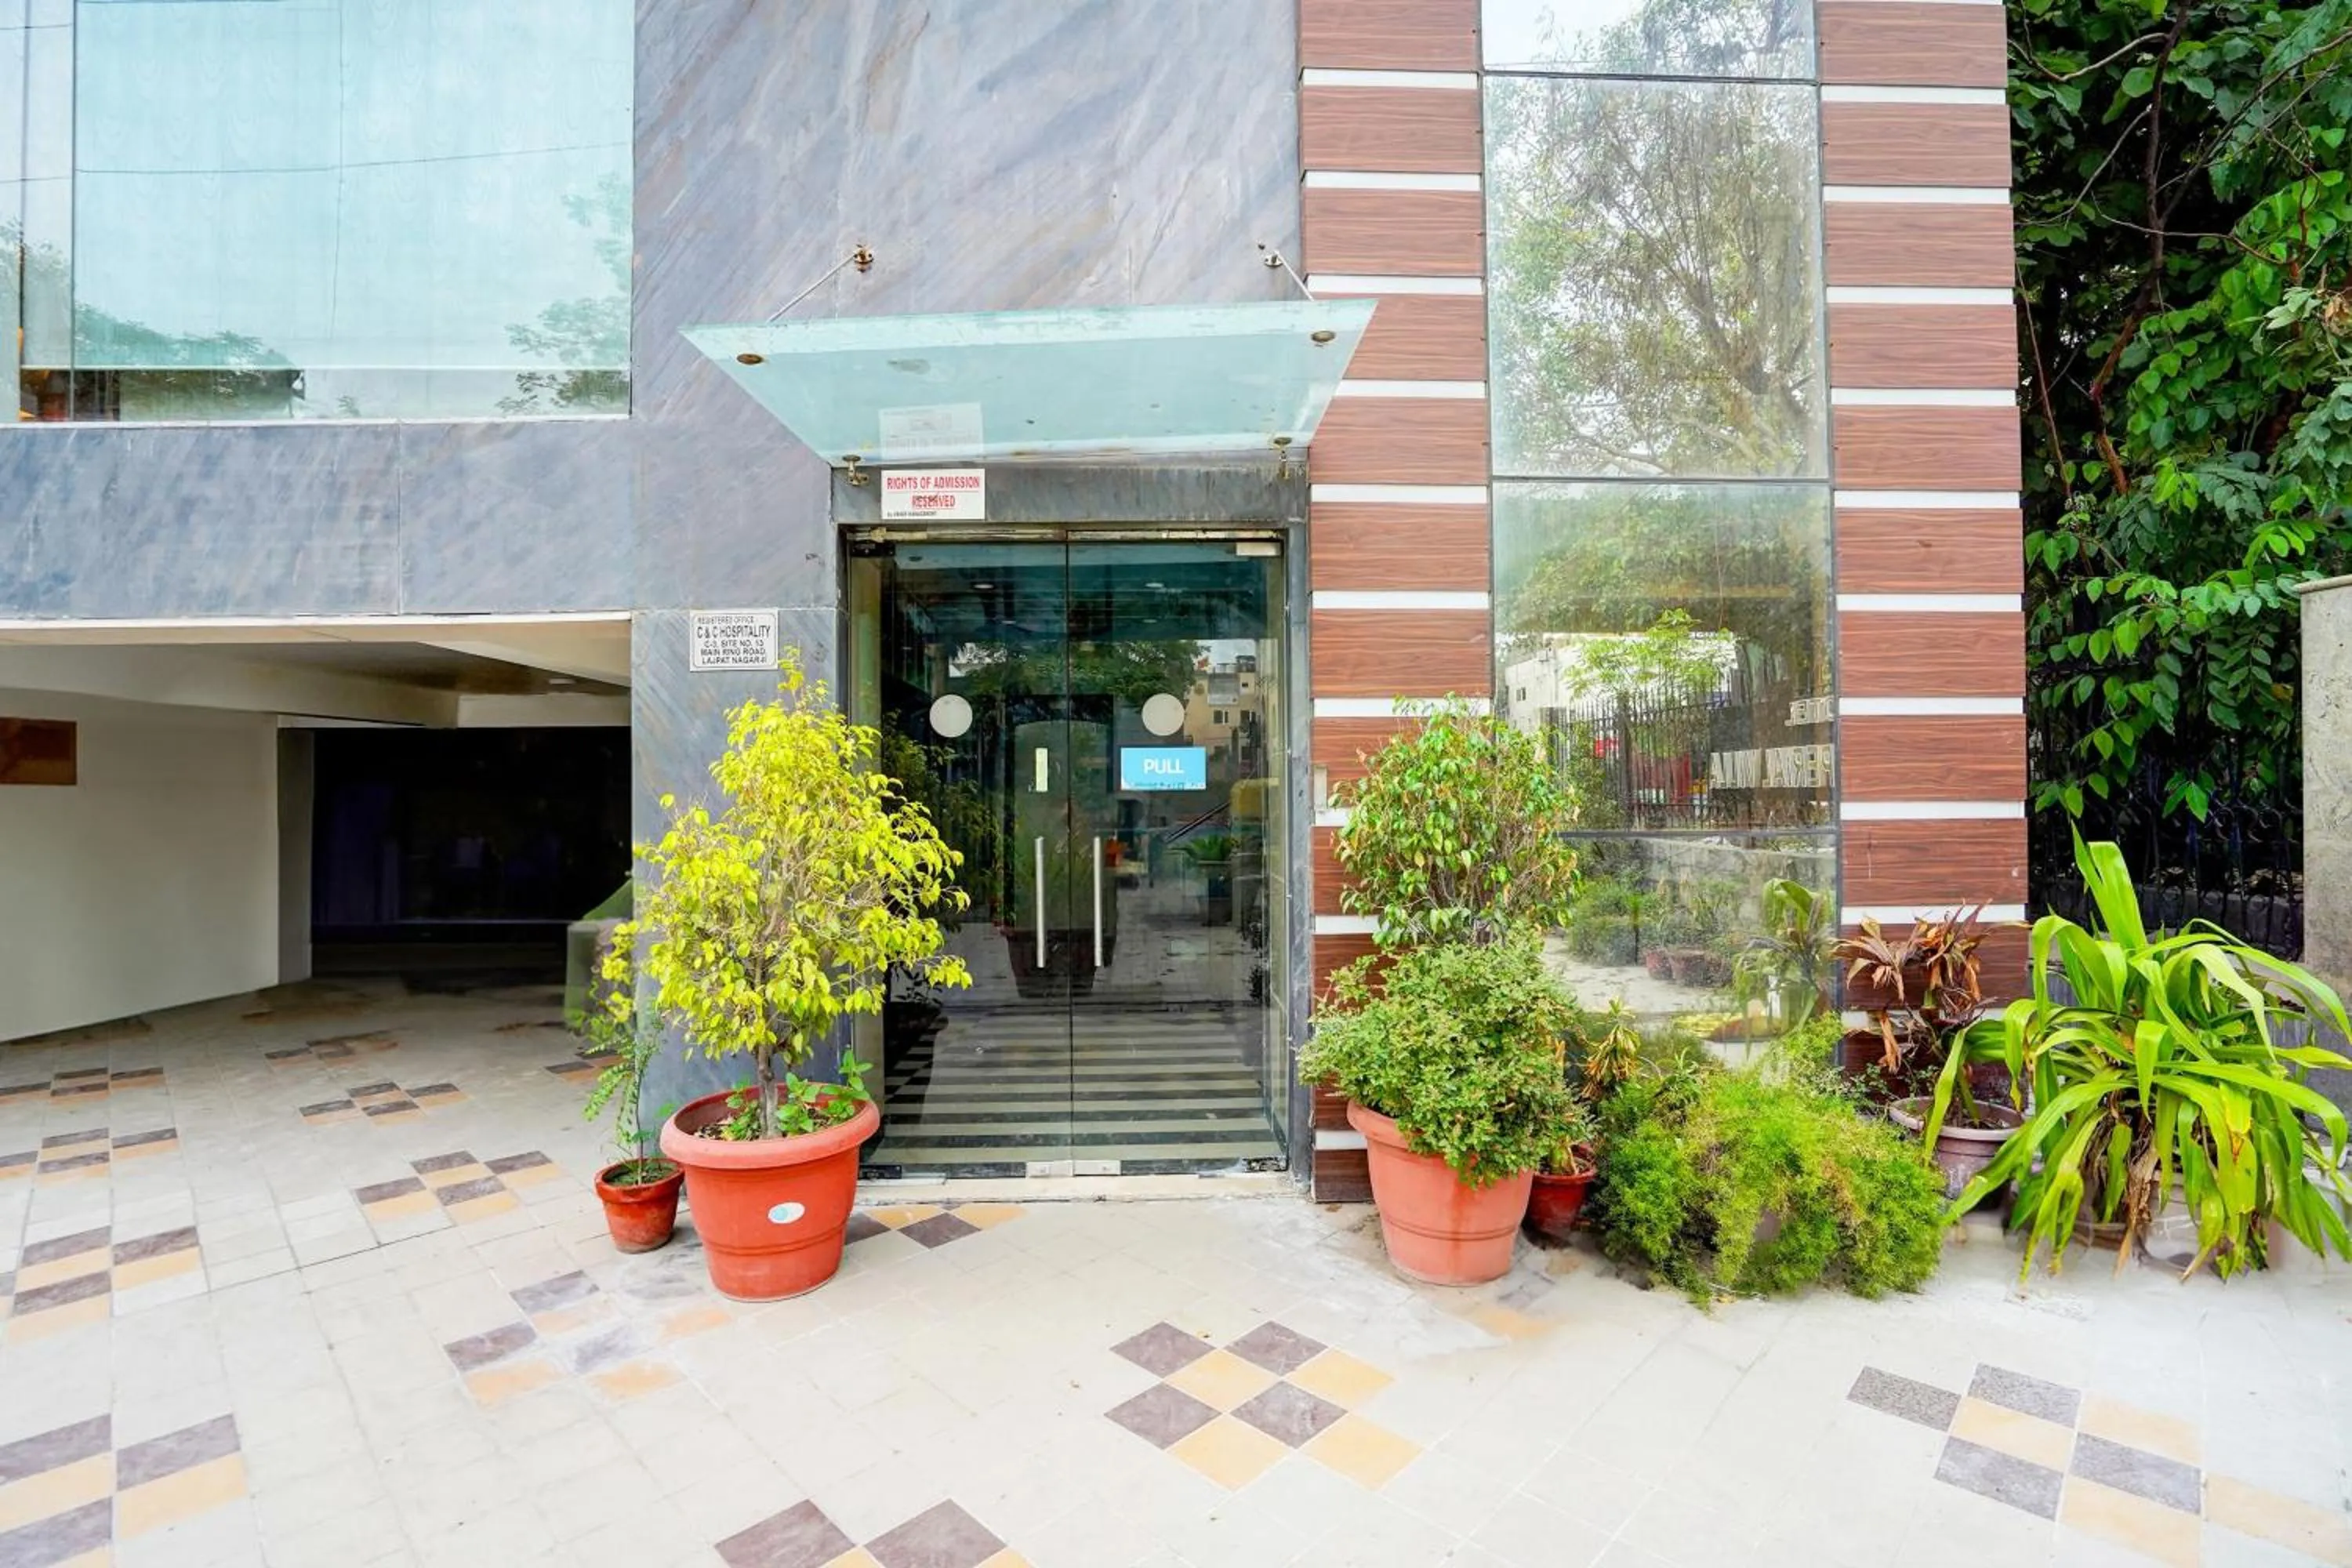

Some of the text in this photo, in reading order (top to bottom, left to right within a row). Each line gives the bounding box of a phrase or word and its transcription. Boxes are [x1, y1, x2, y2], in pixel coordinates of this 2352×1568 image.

[887, 476, 980, 489] RIGHTS OF ADMISSION
[912, 495, 956, 508] RESERVED
[697, 625, 771, 638] C & C HOSPITALITY
[721, 639, 738, 648] SITE
[1144, 758, 1185, 775] PULL
